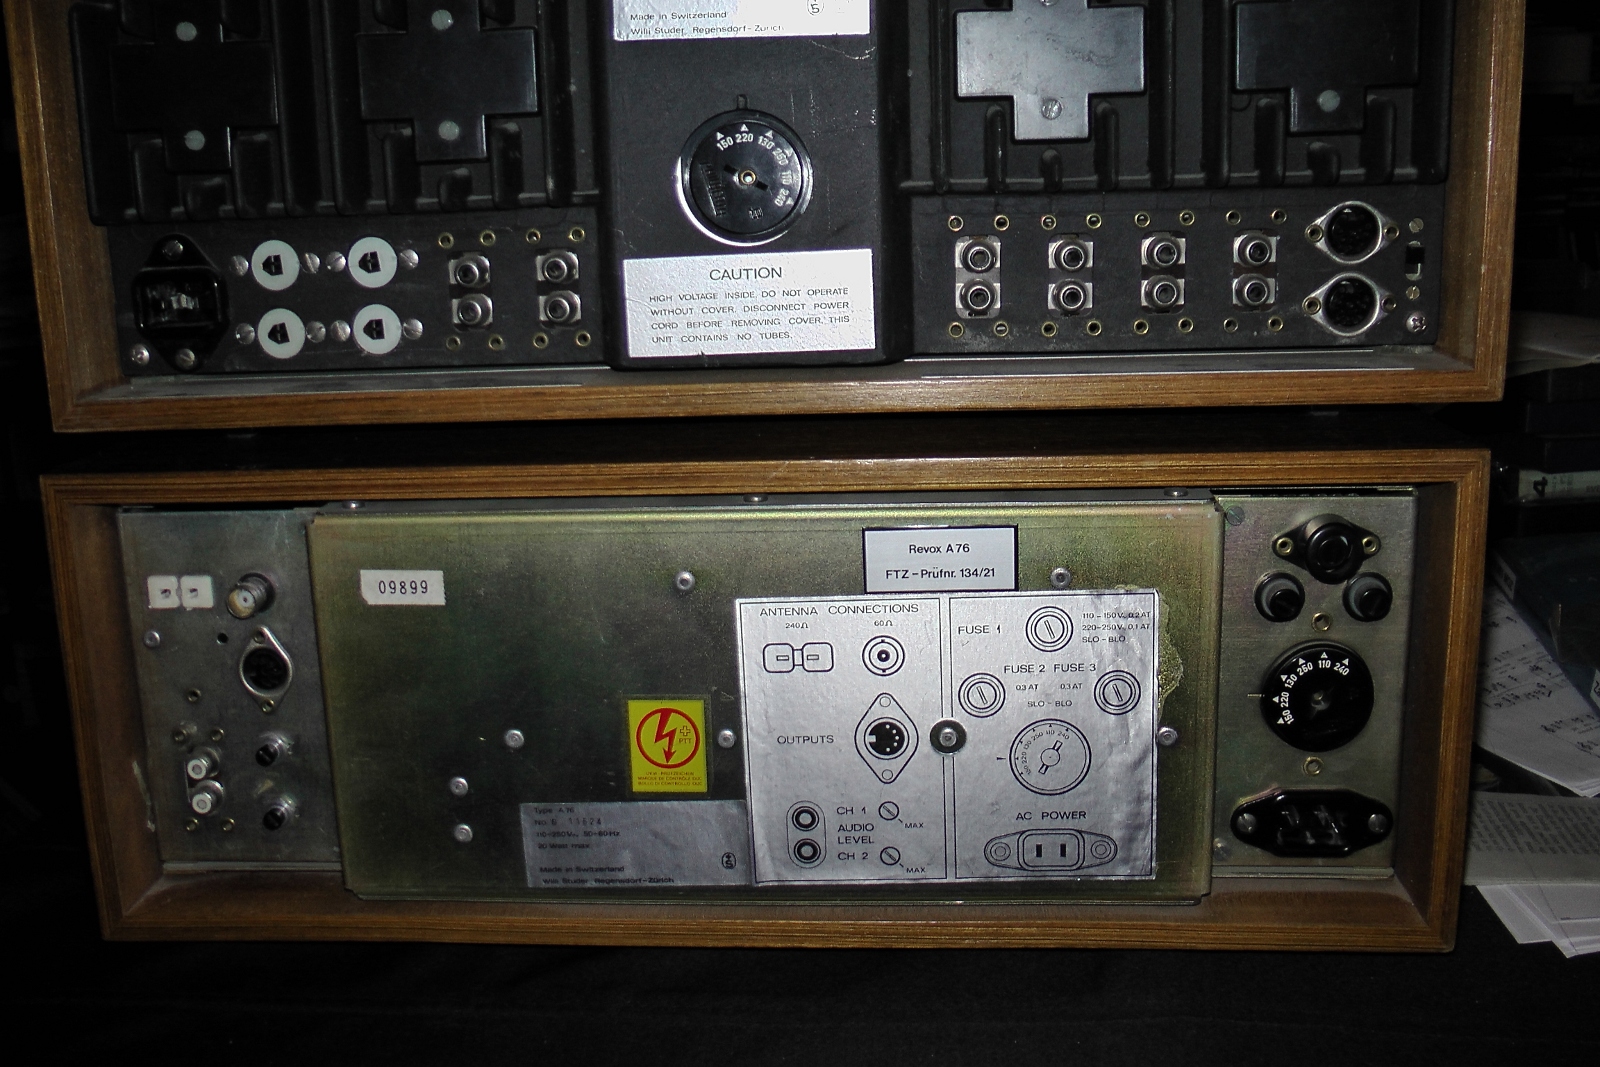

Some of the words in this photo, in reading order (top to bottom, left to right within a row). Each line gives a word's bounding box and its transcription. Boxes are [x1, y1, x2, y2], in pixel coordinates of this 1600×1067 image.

[630, 13, 655, 21] Made
[671, 11, 728, 20] Switzerland
[716, 136, 734, 151] 150
[735, 133, 754, 143] 220
[757, 135, 776, 150] 130
[709, 266, 783, 281] CAUTION
[649, 294, 673, 303] HIGH
[678, 292, 719, 301] VOLTAGE
[761, 289, 776, 298] DO
[782, 289, 802, 297] NOT
[807, 287, 849, 296] OPERATE
[650, 307, 694, 316] WITHOUT
[743, 303, 806, 313] DISCONNECT
[813, 301, 849, 310] POWER
[651, 322, 679, 330] CORD
[686, 320, 723, 329] BEFORE
[731, 318, 781, 327] REMOVING
[828, 315, 850, 323] THIS
[651, 335, 673, 343] UNIT
[680, 333, 729, 343] CONTAINS
[737, 332, 752, 341] NO
[908, 544, 942, 554] Revox
[960, 567, 995, 578] 134/21
[378, 580, 428, 595] 09899
[760, 606, 819, 617] ANTENNA
[828, 603, 919, 615] CONNECTIONS
[958, 625, 990, 635] FUSE
[1003, 664, 1035, 674] FUSE
[1038, 664, 1046, 673] 2
[1053, 663, 1085, 673] FUSE
[1089, 663, 1097, 672] 3
[1318, 659, 1332, 669] 110
[1333, 662, 1350, 676] 240
[1284, 673, 1298, 689] 130
[1280, 691, 1290, 708] 220
[1282, 709, 1295, 725] 150
[777, 735, 835, 745] OUTPUTS
[836, 806, 854, 815] CH
[861, 806, 867, 815] 1
[1015, 811, 1033, 821] AC
[1041, 810, 1087, 821] POWER
[837, 823, 875, 832] AUDIO
[837, 835, 875, 845] LEVEL
[837, 851, 855, 861] CH
[861, 851, 869, 860] 2
[575, 865, 625, 873] Switzerland
[906, 866, 926, 874] MAX
